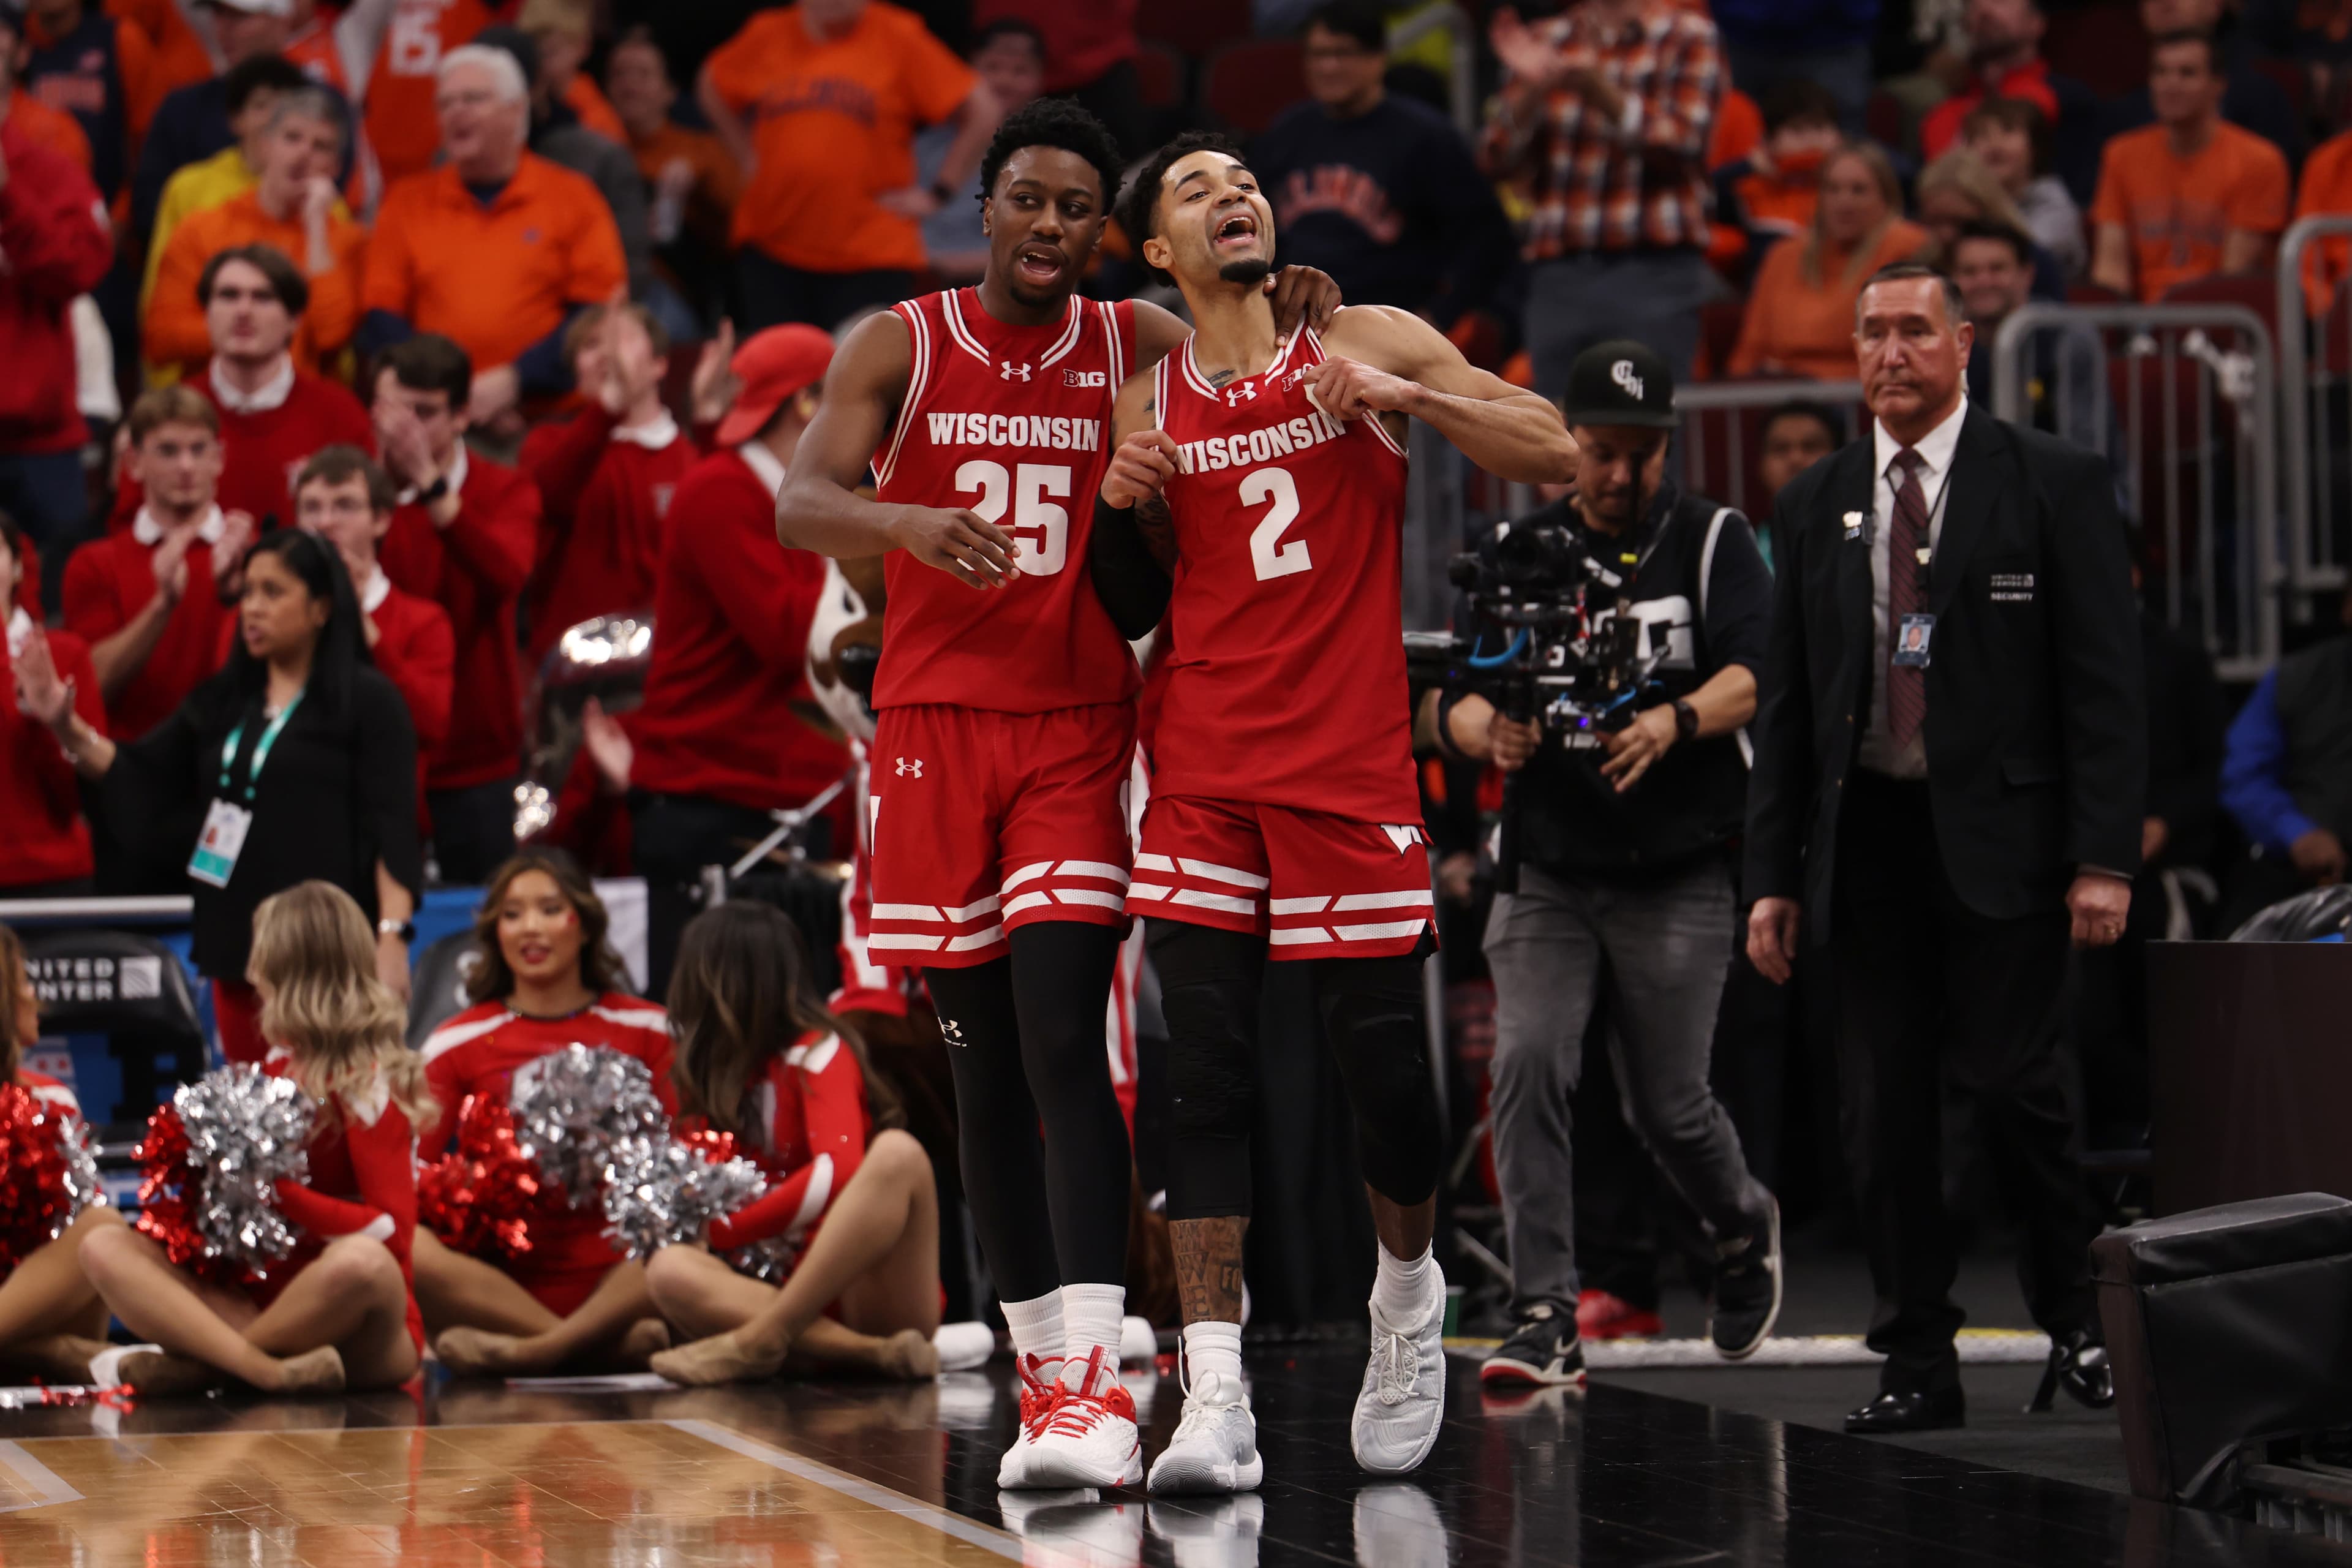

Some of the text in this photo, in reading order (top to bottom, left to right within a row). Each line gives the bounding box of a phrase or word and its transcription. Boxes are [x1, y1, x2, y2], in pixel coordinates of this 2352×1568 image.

[927, 413, 1100, 451] WISCONSIN
[1175, 412, 1346, 475] WISCONSIN
[955, 460, 1071, 576] 25
[1238, 467, 1313, 581] 2
[23, 957, 115, 979] NITED
[37, 980, 113, 1001] NTER
